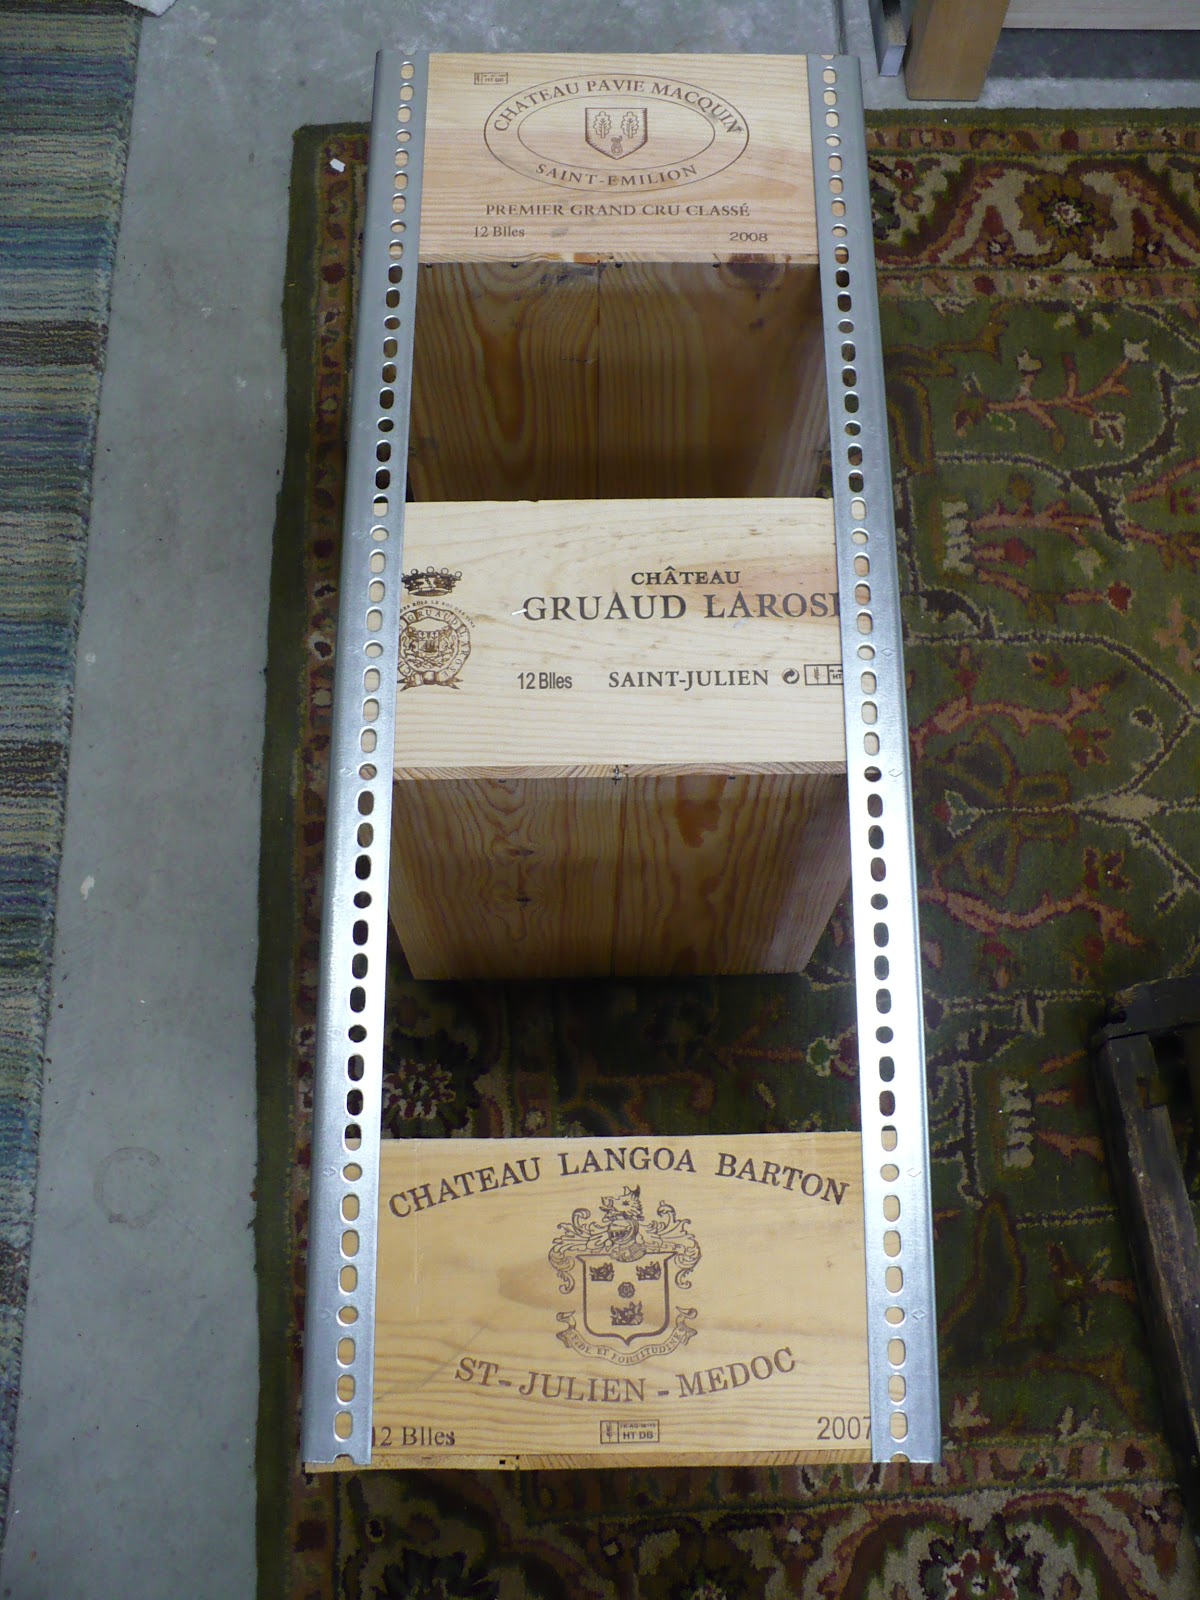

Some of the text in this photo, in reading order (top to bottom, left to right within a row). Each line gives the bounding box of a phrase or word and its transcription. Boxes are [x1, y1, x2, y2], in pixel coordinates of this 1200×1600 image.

[494, 79, 743, 134] CHATEAU PAVIE MACQUIN
[536, 164, 698, 186] SAINT-EMILION
[486, 202, 750, 216] PREMIER GRAND CRU CLASSÉ
[474, 226, 525, 238] 12 Blles
[729, 232, 768, 242] 2008
[631, 566, 740, 586] CHÂTEAU
[523, 592, 687, 621] GRUAUD
[407, 609, 469, 677] GRUAUD LAROSE
[518, 672, 572, 690] 12 Blles
[608, 670, 768, 692] SAINT-JULIEN
[389, 1146, 850, 1218] CHATEAU LANGOA BARTON
[597, 1348, 610, 1356] ET
[676, 1347, 796, 1398] MEDOC
[402, 1426, 456, 1446] Blles
[623, 1431, 654, 1440] HT DB
[817, 1416, 871, 1440] 2007
